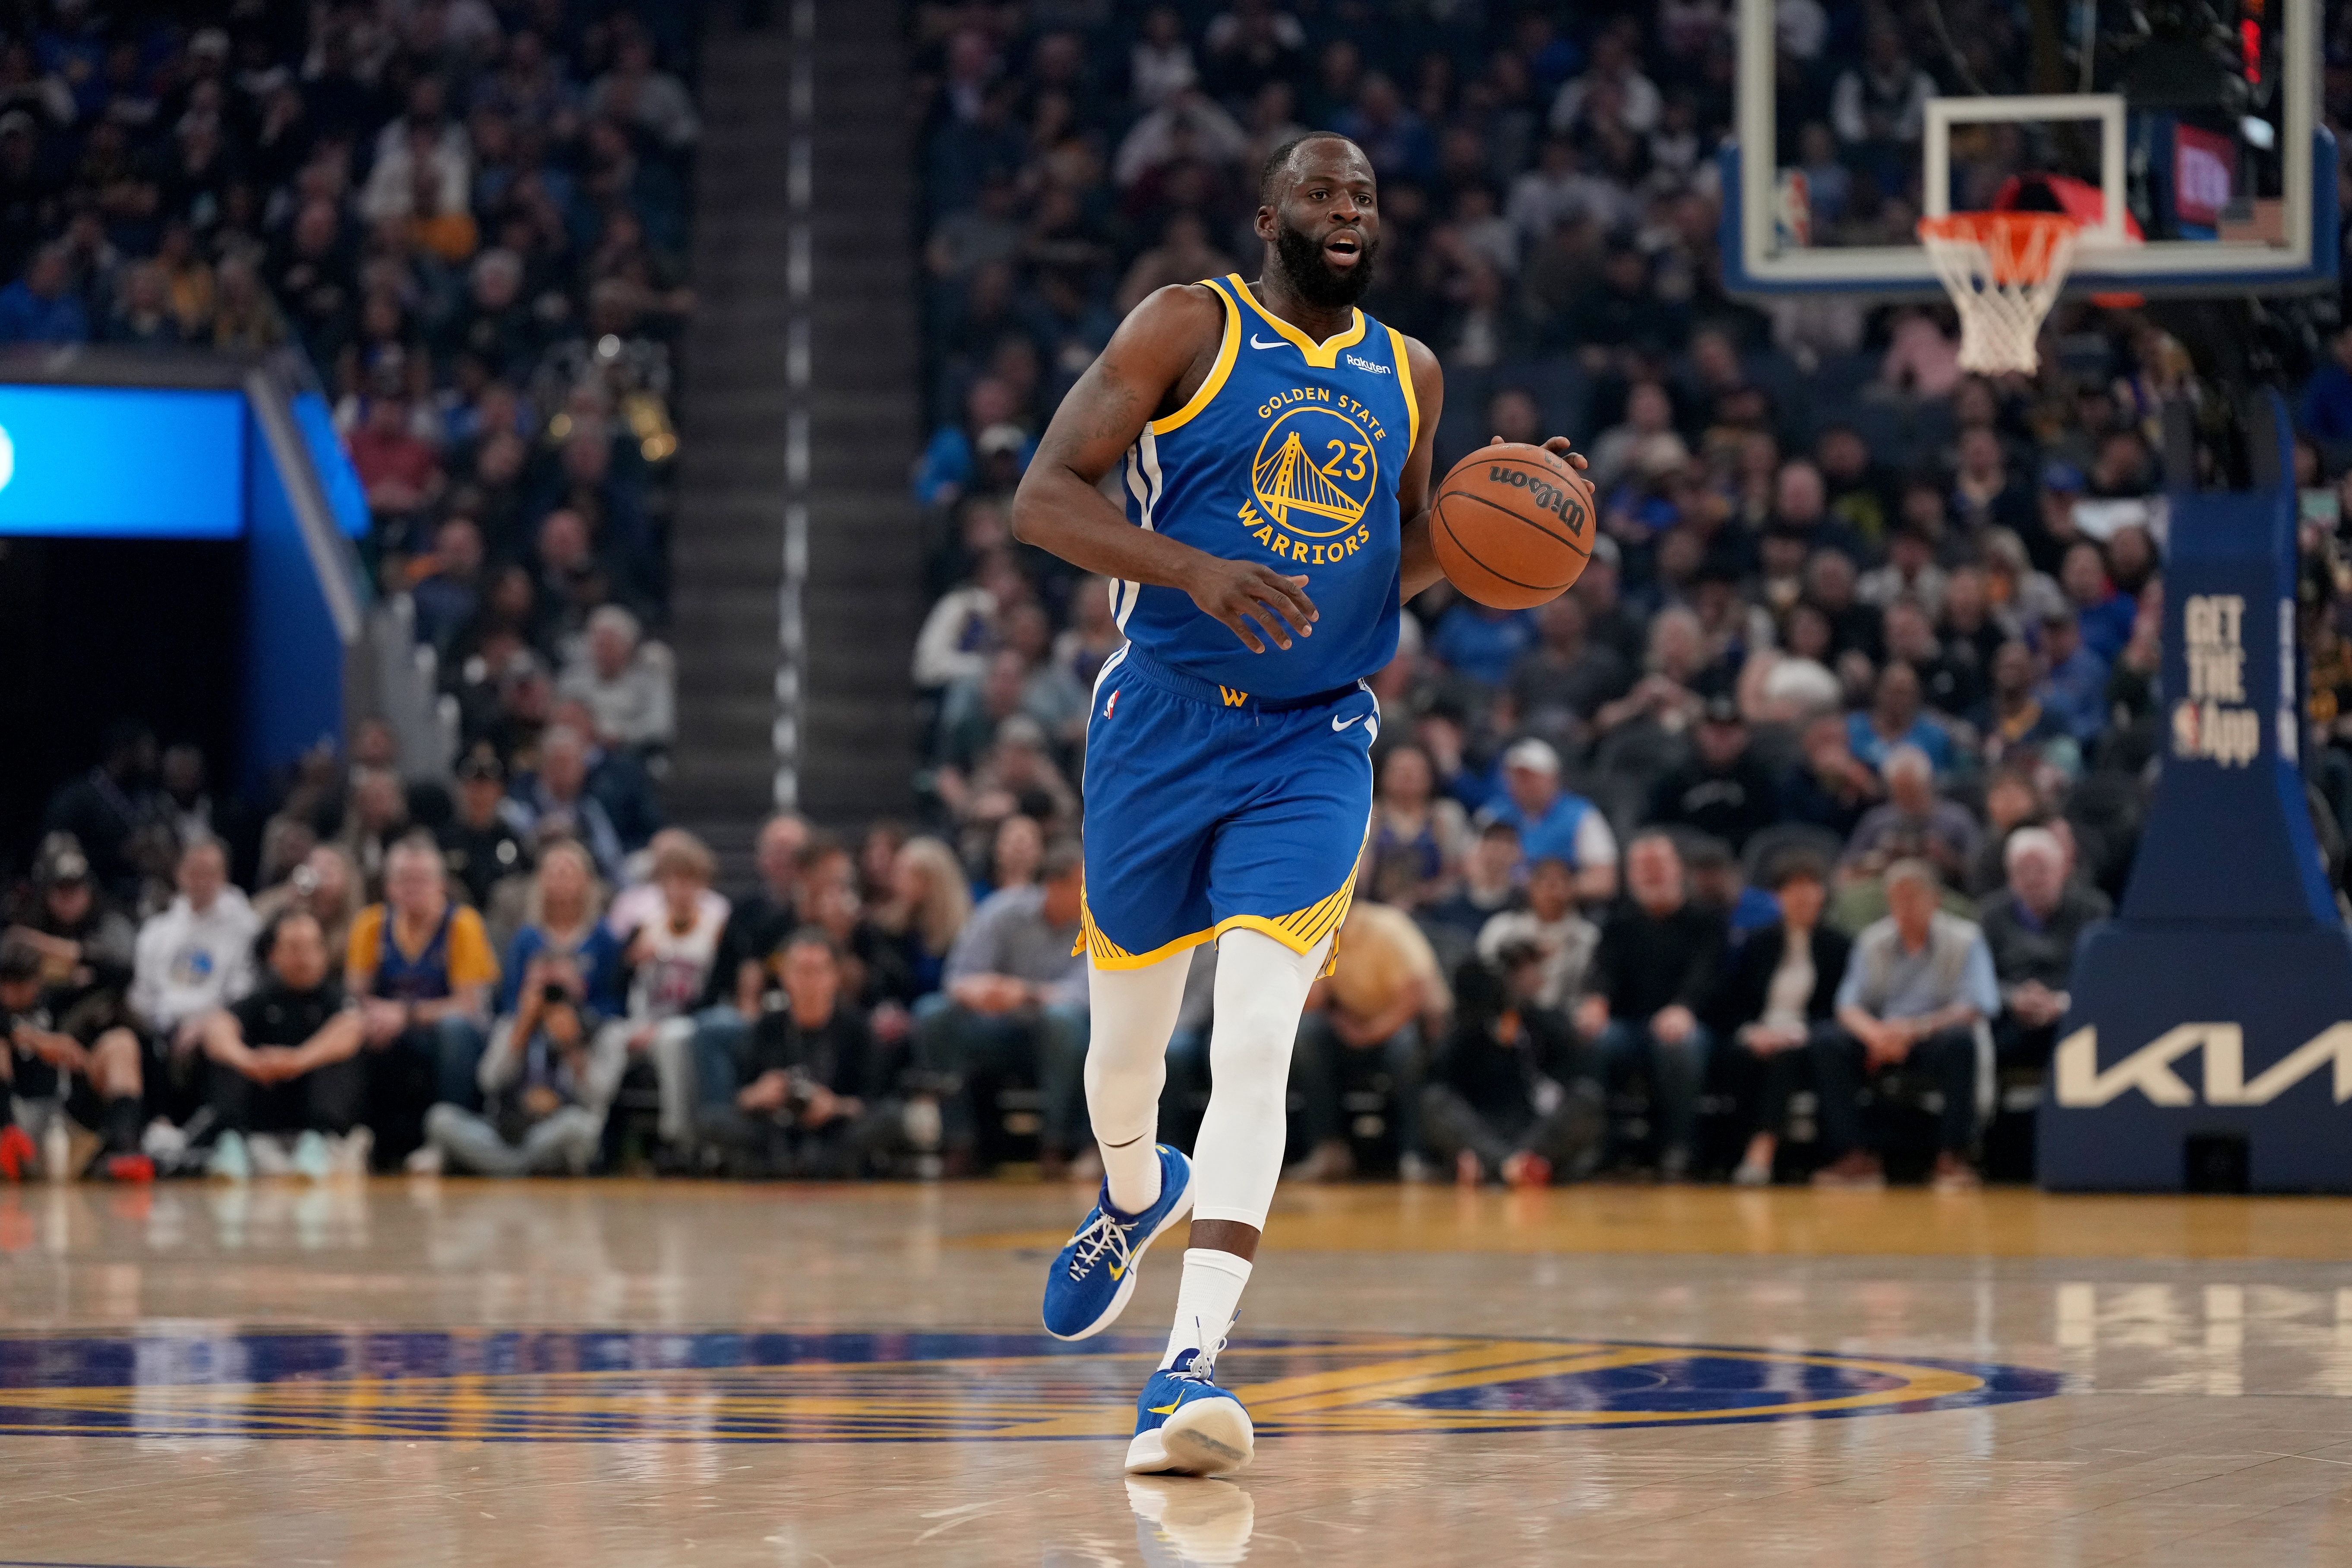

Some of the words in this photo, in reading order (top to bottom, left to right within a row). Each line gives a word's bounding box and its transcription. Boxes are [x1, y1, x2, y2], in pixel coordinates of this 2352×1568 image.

[1347, 354, 1391, 374] Rakuten
[1258, 388, 1329, 419] GOLDEN
[1338, 395, 1386, 441] STATE
[1322, 439, 1368, 481] 23
[1488, 466, 1585, 538] Wilson
[1237, 498, 1369, 564] WARRIORS
[1219, 685, 1248, 707] W
